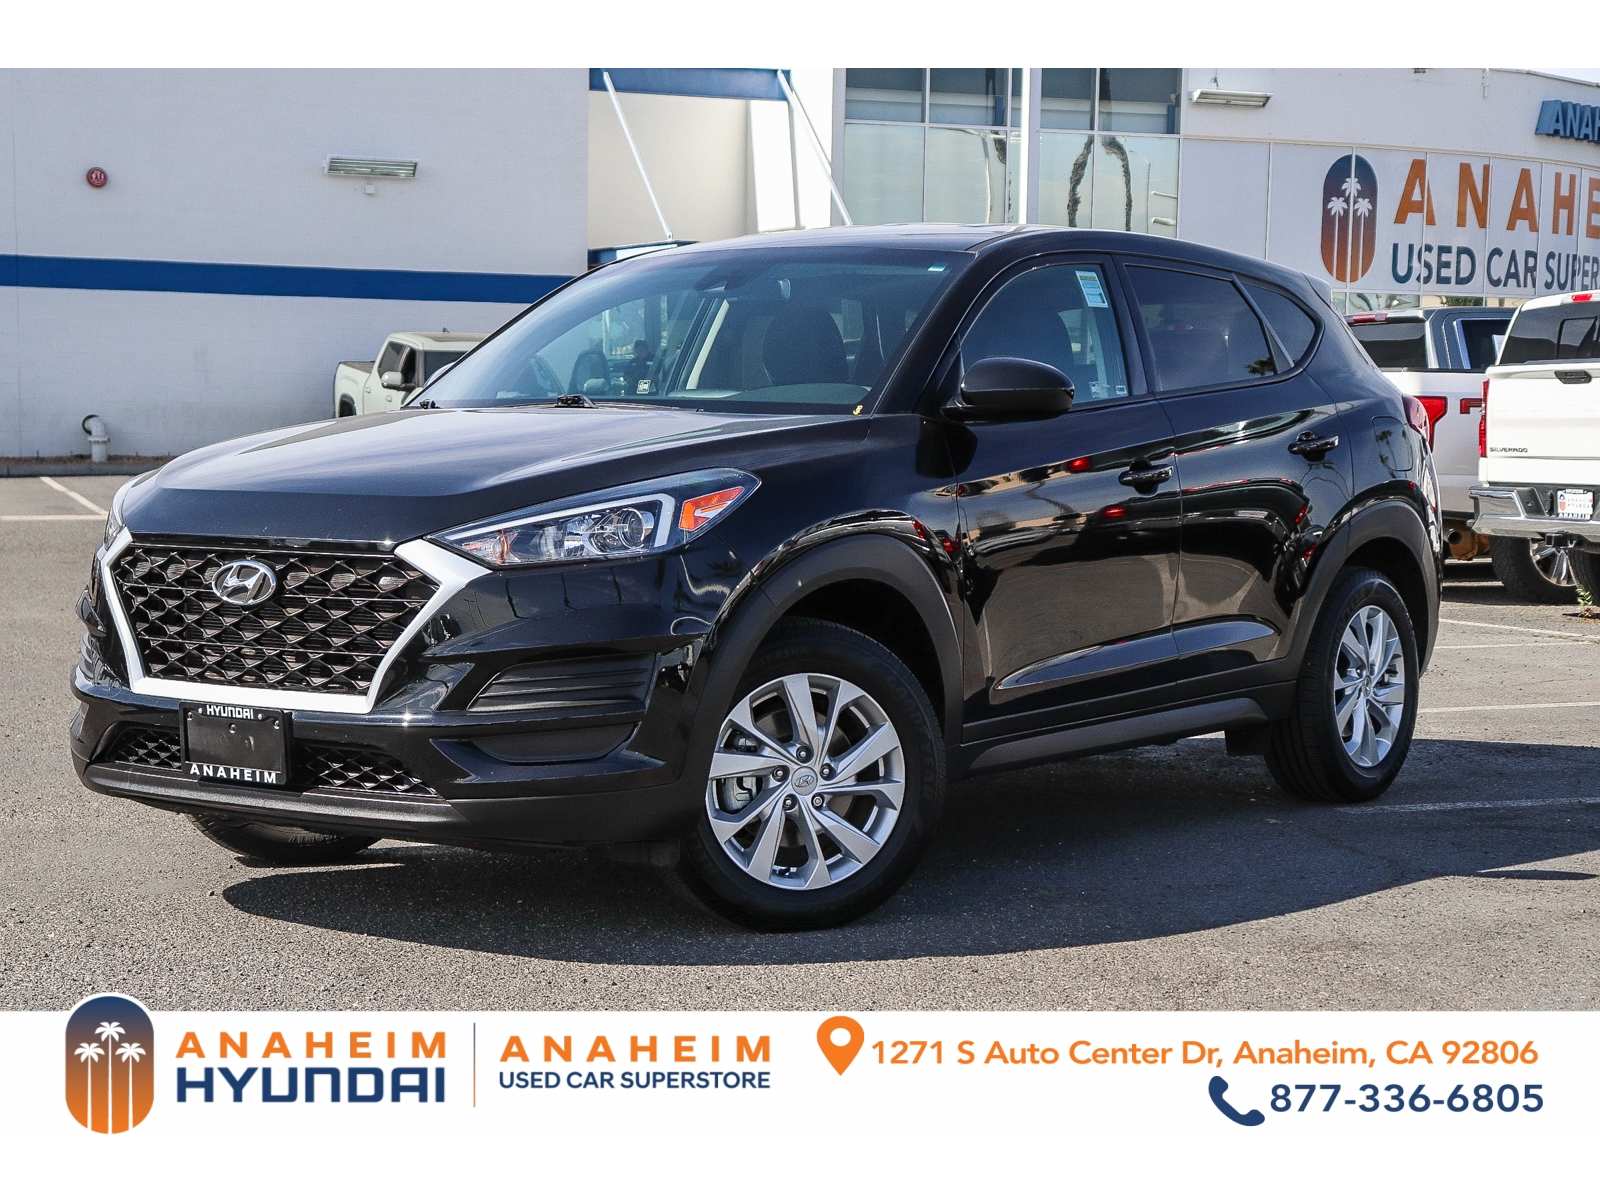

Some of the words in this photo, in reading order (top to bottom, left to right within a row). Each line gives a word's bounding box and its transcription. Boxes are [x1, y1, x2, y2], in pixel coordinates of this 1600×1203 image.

[1394, 158, 1600, 239] ANAHE
[1391, 243, 1477, 285] USED
[1486, 247, 1538, 288] CAR
[1544, 250, 1600, 291] SUPER
[206, 704, 254, 720] HYUNDAI
[189, 762, 277, 784] ANAHEIM
